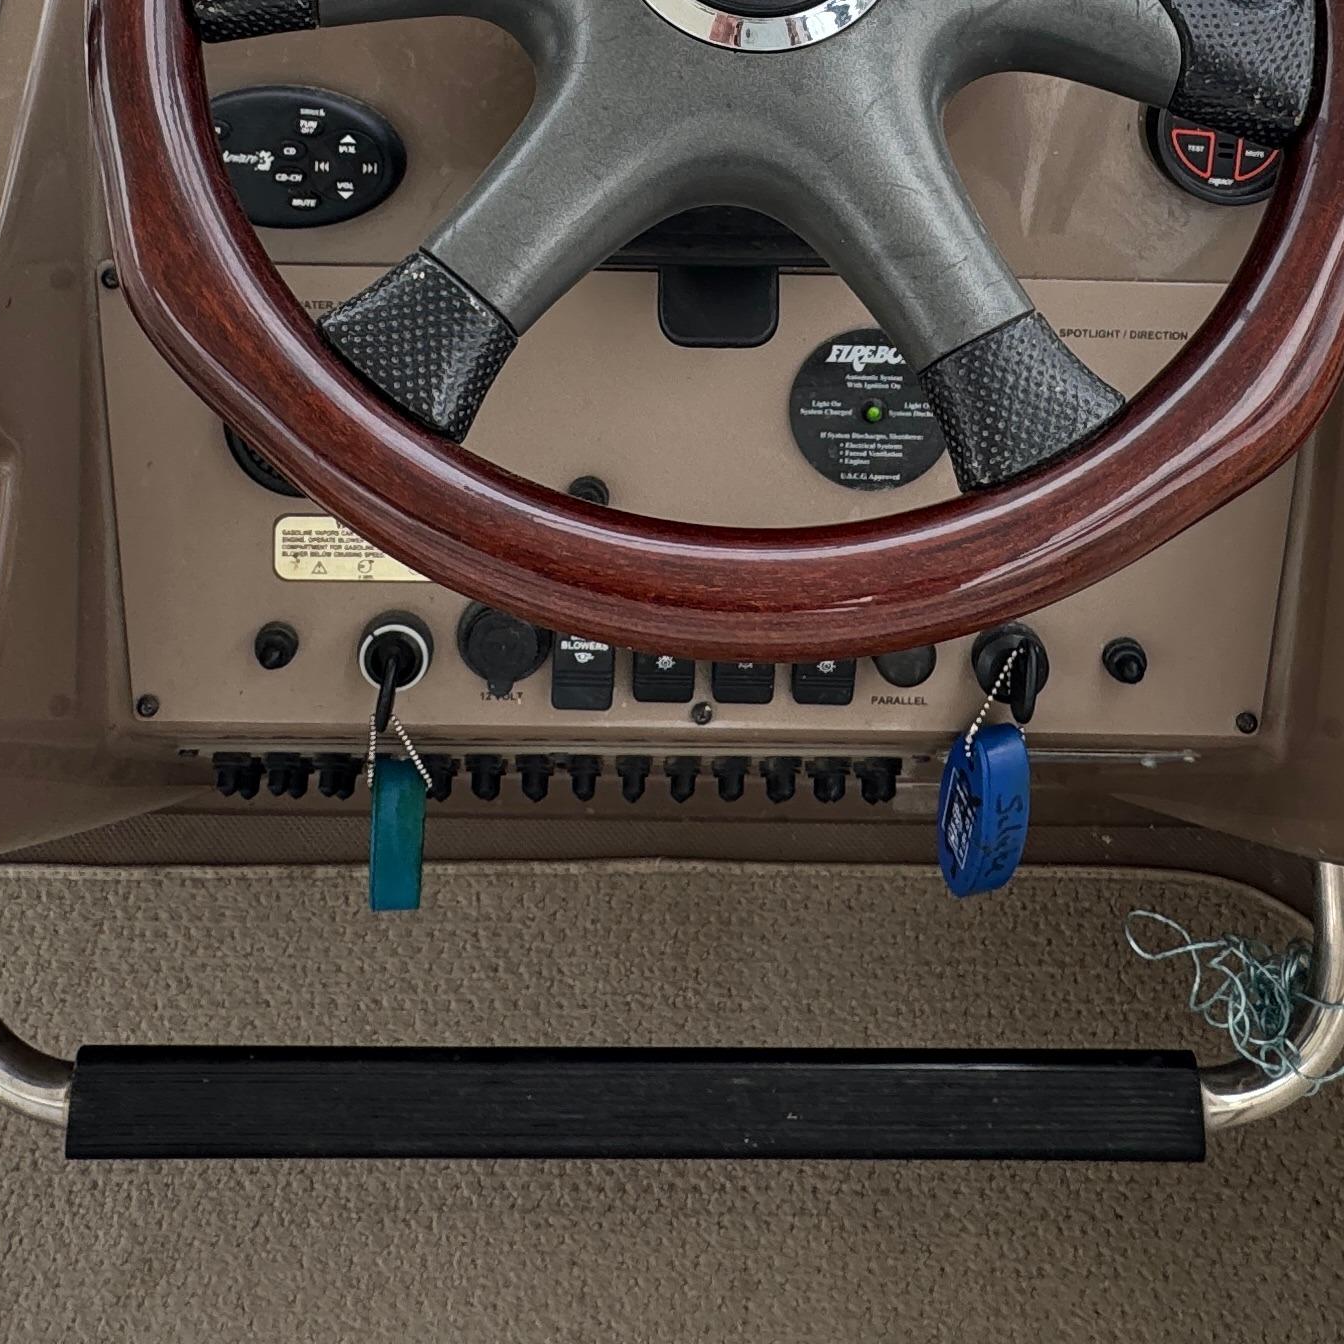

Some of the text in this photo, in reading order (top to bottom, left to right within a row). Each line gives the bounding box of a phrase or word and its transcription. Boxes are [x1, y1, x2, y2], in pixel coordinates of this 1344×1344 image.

[283, 147, 296, 156] CD
[1187, 144, 1205, 153] TEST
[1059, 329, 1120, 339] SPOTLIGHT
[1129, 331, 1189, 341] DIRECTION
[825, 344, 907, 372] FIREBO
[812, 399, 830, 408] Light
[560, 641, 609, 651] BLOWERS
[480, 692, 491, 701] 12
[871, 695, 928, 705] PARALLEL
